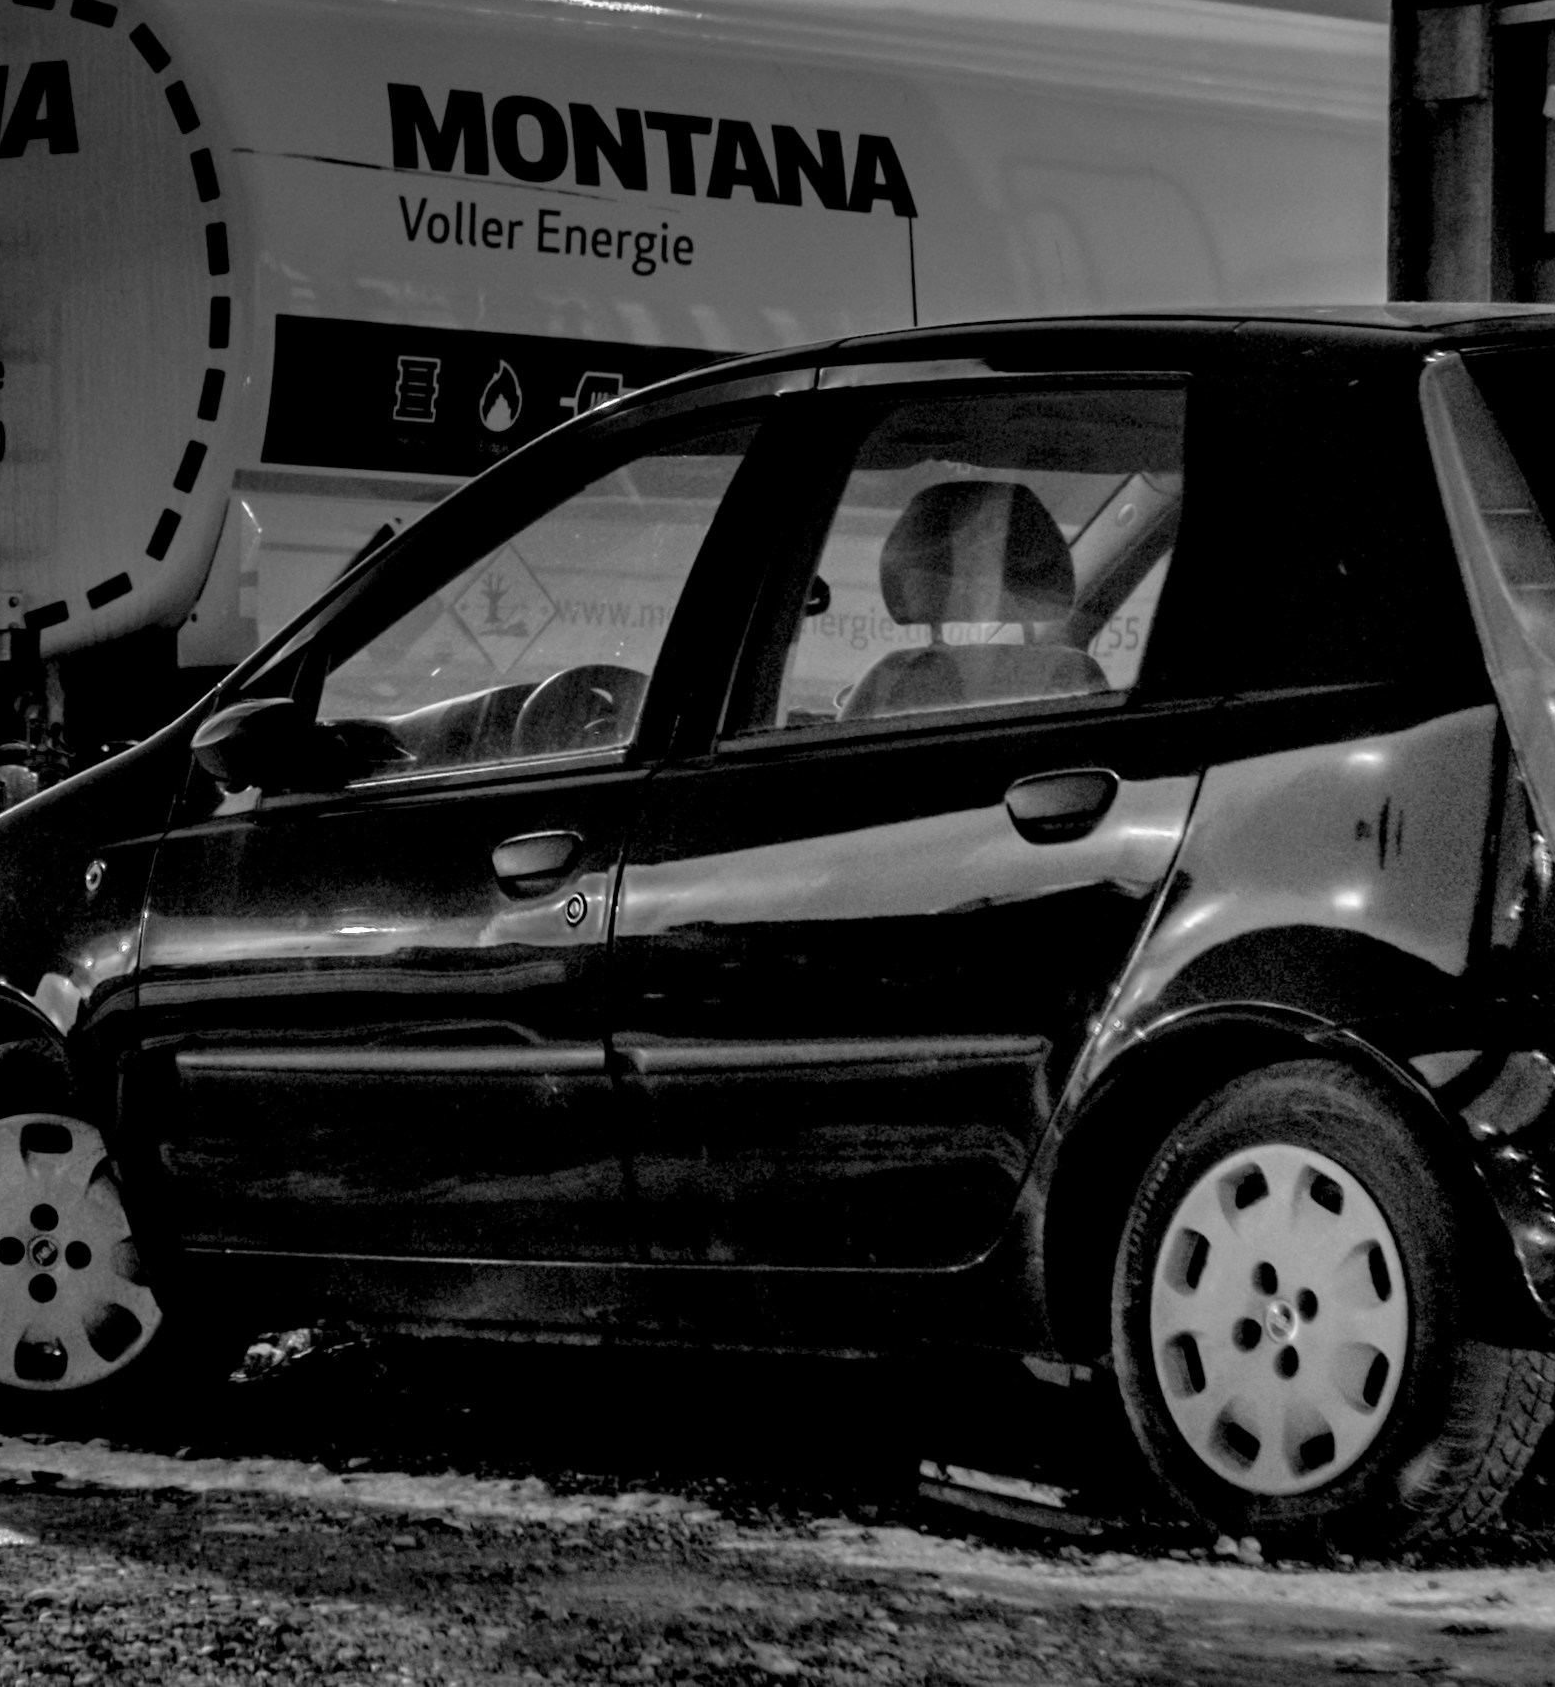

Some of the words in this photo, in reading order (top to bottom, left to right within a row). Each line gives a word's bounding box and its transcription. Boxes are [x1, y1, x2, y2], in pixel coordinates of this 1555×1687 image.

[388, 83, 918, 218] MONTANA
[399, 196, 523, 250] Voller
[537, 209, 694, 276] Energie
